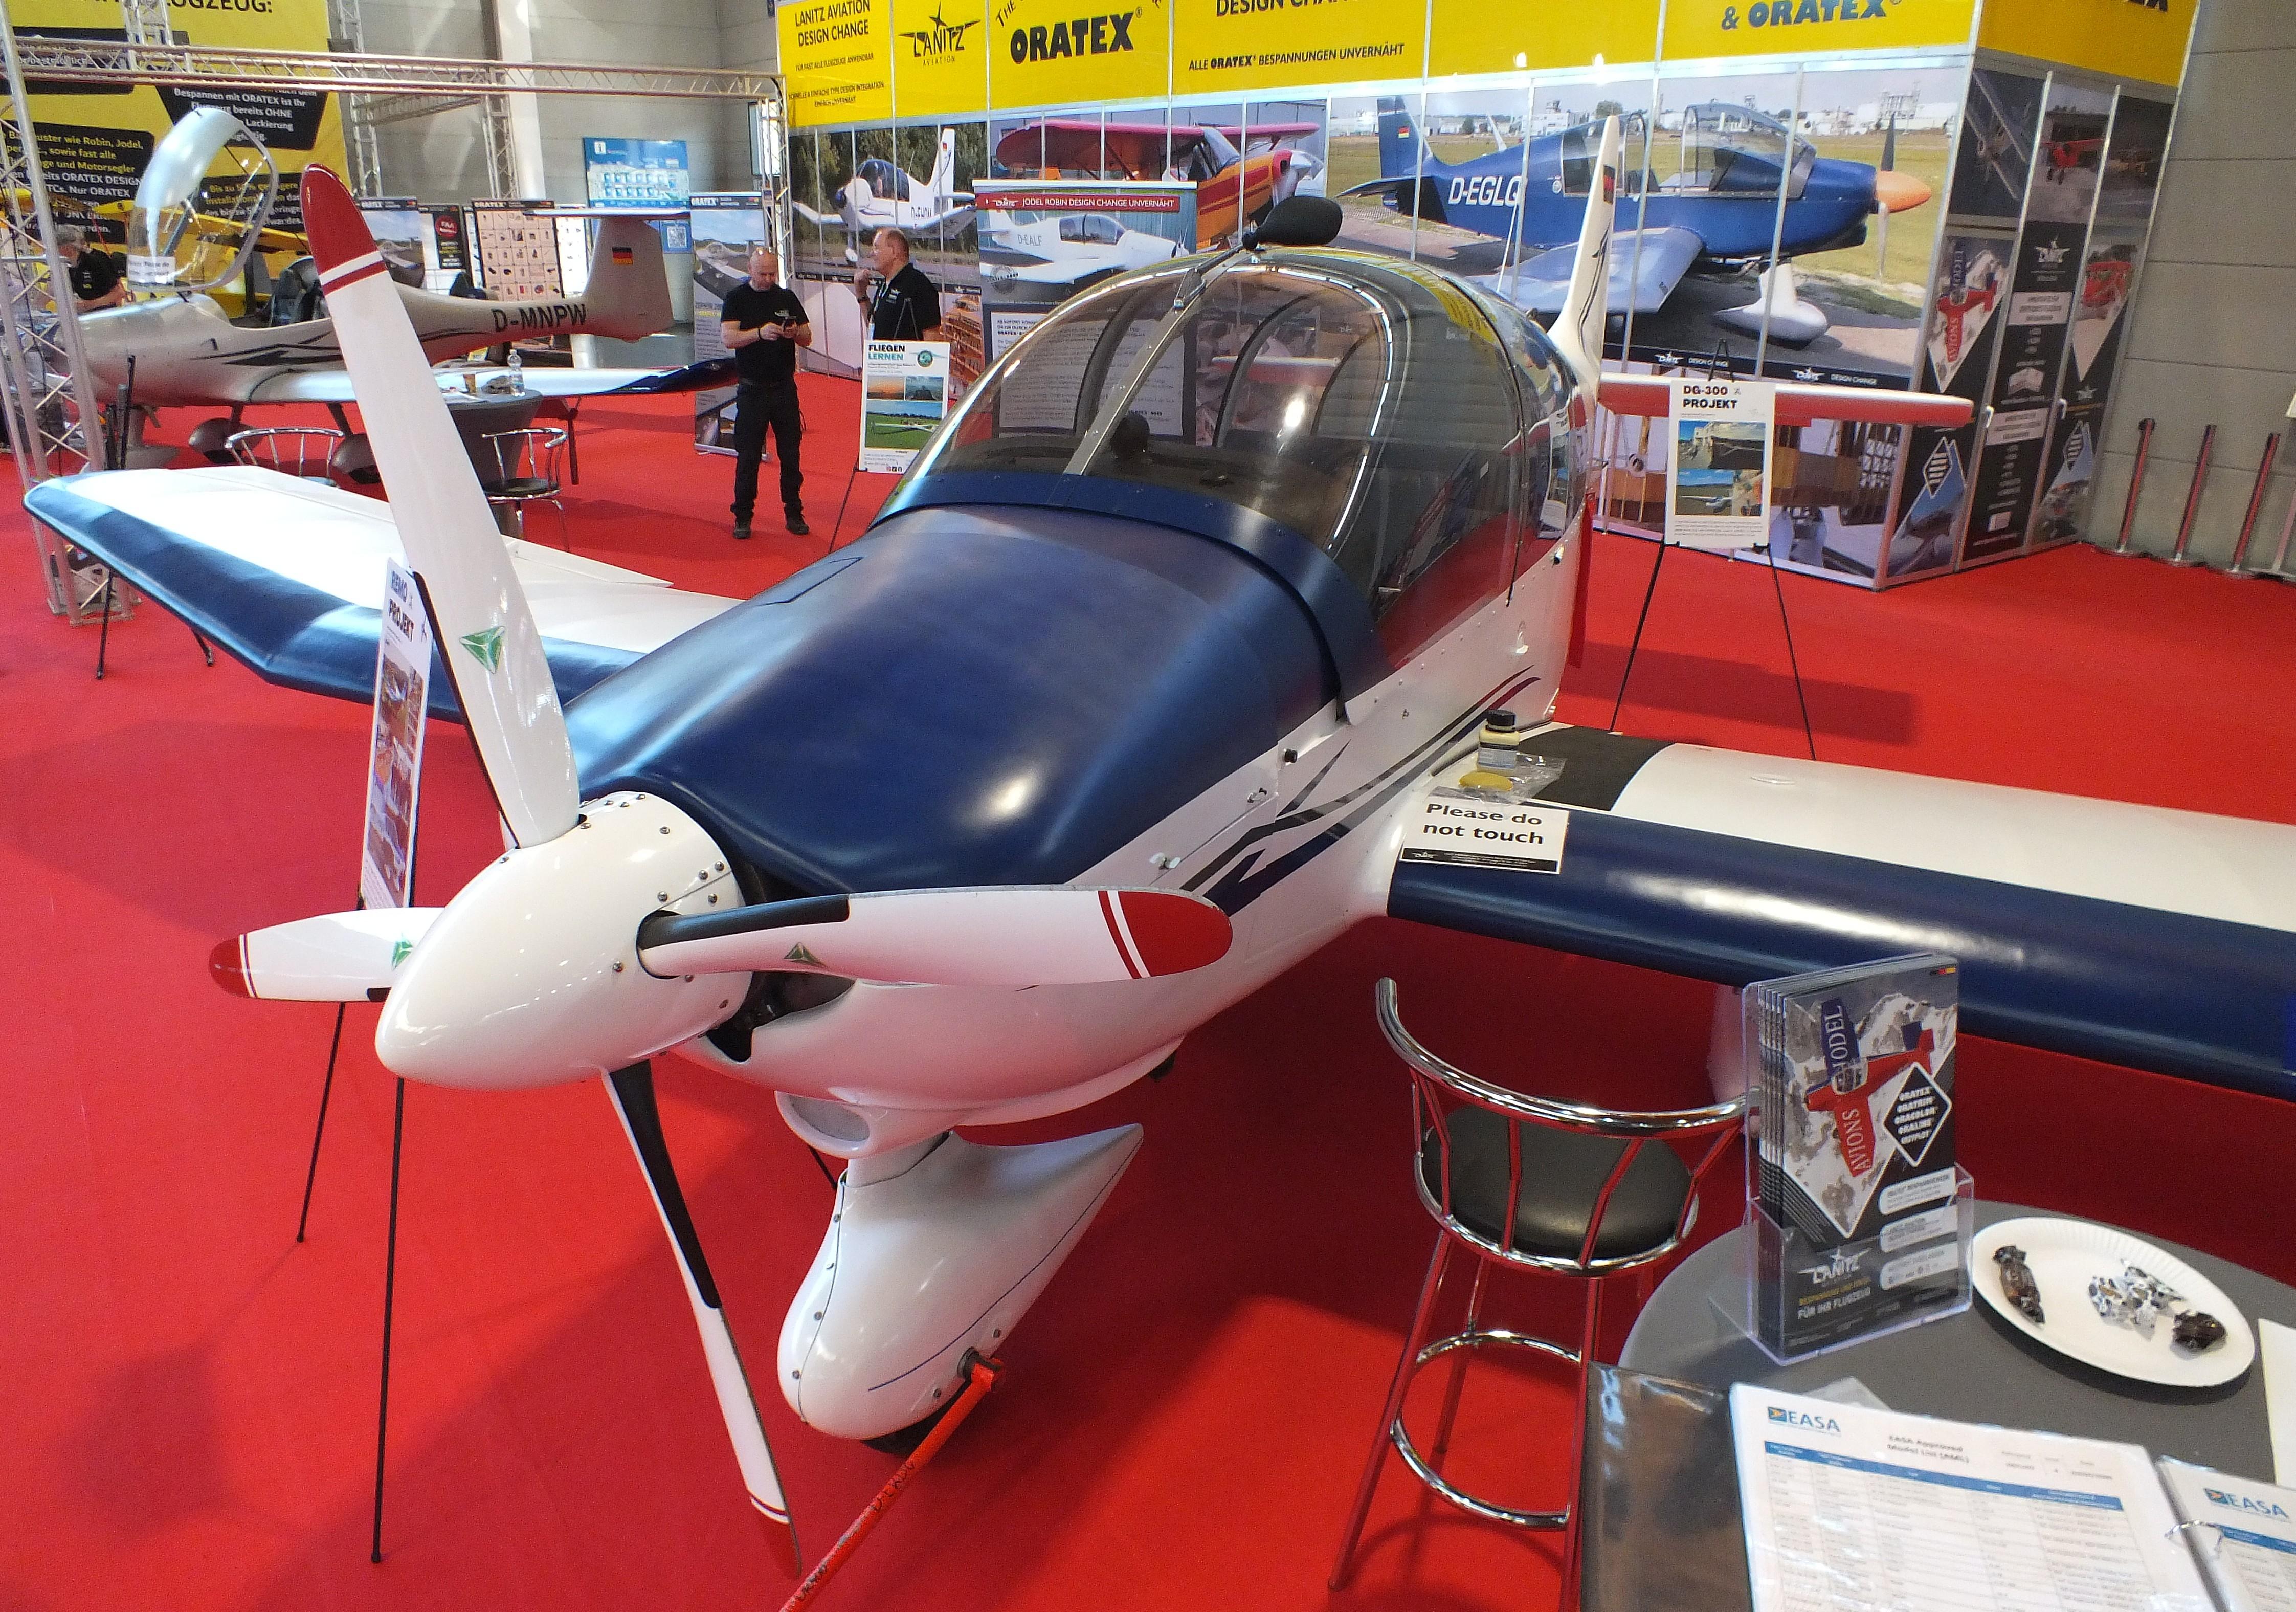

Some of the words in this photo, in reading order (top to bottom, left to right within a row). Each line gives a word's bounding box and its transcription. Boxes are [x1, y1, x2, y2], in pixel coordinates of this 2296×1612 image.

[795, 6, 825, 27] LANITZ
[827, 0, 870, 20] AVIATION
[1721, 6, 1739, 30] &
[798, 27, 829, 47] DESIGN
[831, 19, 869, 41] CHANGE
[913, 23, 965, 57] LANITZ
[922, 55, 955, 66] AVIATION
[1188, 59, 1208, 71] ALLE
[1258, 48, 1336, 65] BESPANNUNGEN
[1339, 41, 1405, 60] UNVERNÄHT
[174, 87, 224, 101] Bespannen
[225, 91, 240, 101] mit
[242, 93, 280, 105] ORATEX
[232, 105, 263, 116] bereits
[265, 107, 293, 118] OHNE
[246, 118, 294, 131] Lackierung
[64, 136, 81, 144] wie
[79, 148, 98, 158] fast
[100, 151, 117, 160] alle
[56, 161, 75, 169] und
[77, 161, 136, 174] Motorsegler
[62, 172, 103, 183] ORATEX
[90, 188, 130, 197] ORATEX
[1022, 198, 1043, 207] JODEL
[1045, 198, 1068, 207] ROBIN
[1069, 198, 1095, 207] DESIGN
[1096, 198, 1127, 207] CHANGE
[491, 303, 587, 333] D-MNPW
[868, 344, 905, 353] FLIEGEN
[868, 352, 904, 361] LERNEN
[1683, 385, 1728, 395] DG-300
[1683, 399, 1737, 409] PROJEKT
[389, 599, 414, 642] PROJEKT
[1426, 804, 1503, 821] Please
[1511, 813, 1543, 825] do
[1423, 824, 1465, 837] not
[1473, 827, 1544, 844] touch
[1842, 1109, 1871, 1171] AVIONS
[1787, 1411, 1840, 1432] EASA
[2225, 1492, 2289, 1518] EASA
